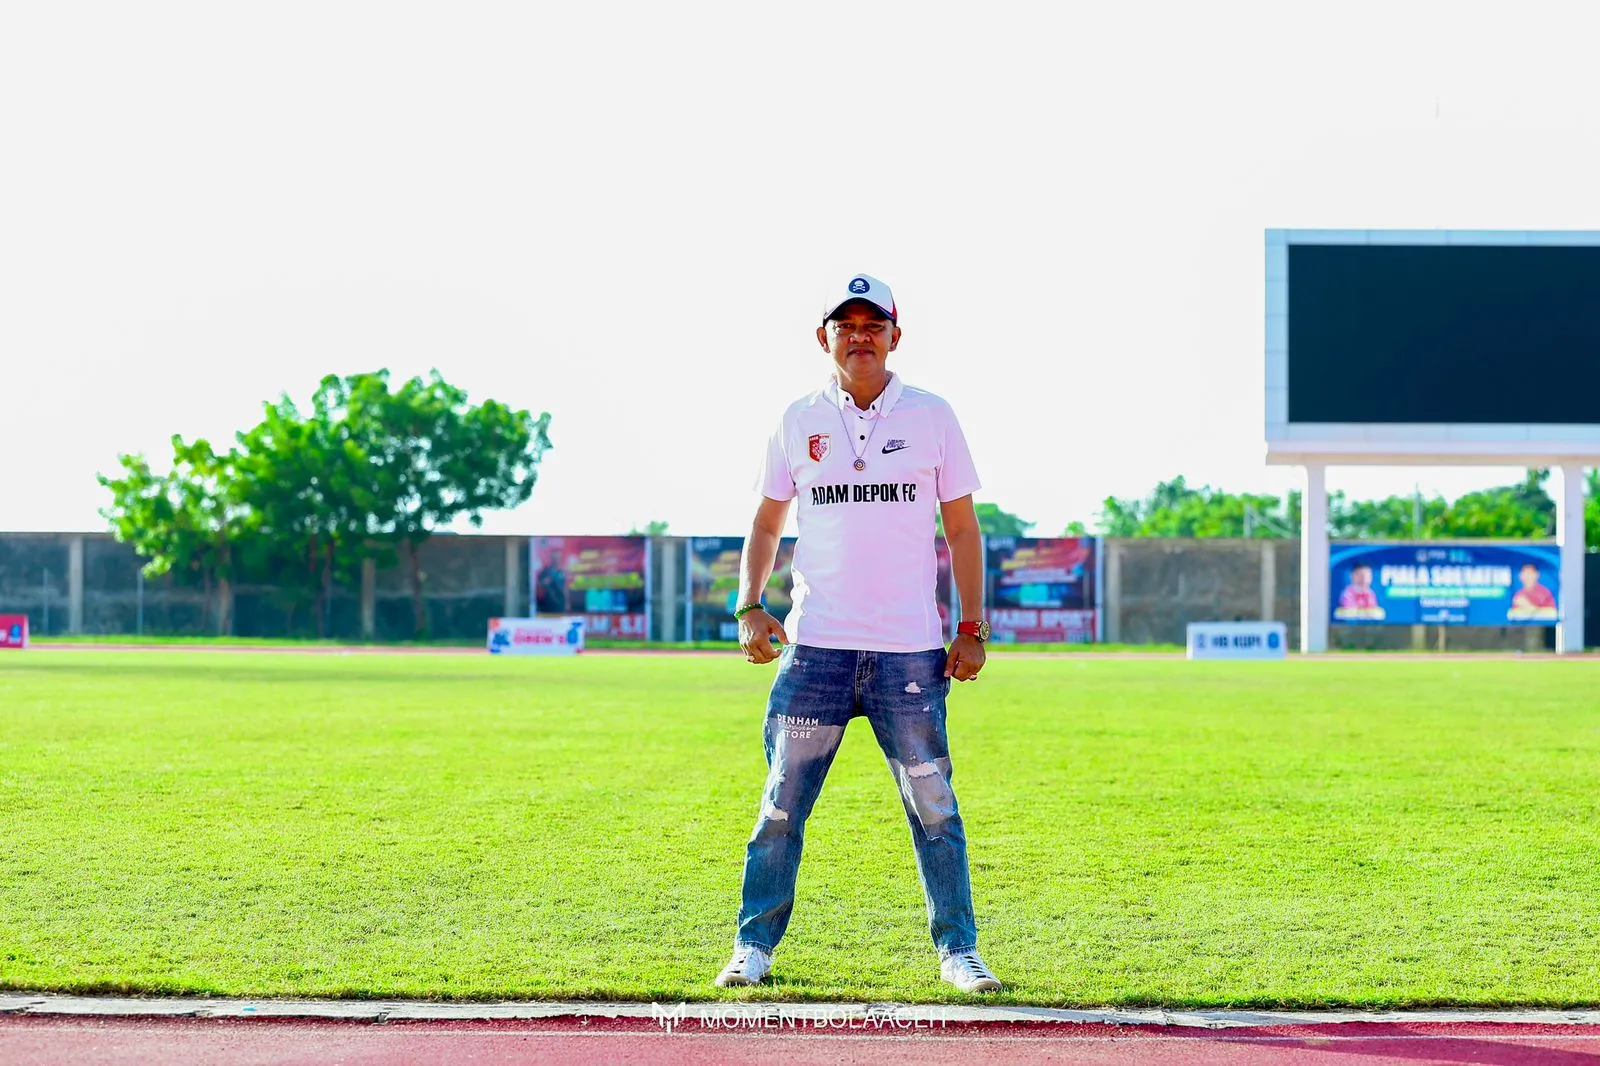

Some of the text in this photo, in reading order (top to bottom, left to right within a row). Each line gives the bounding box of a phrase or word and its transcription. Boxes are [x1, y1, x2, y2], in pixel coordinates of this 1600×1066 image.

[811, 483, 917, 506] ADAM DEPOK FC
[776, 713, 819, 726] DENHAM
